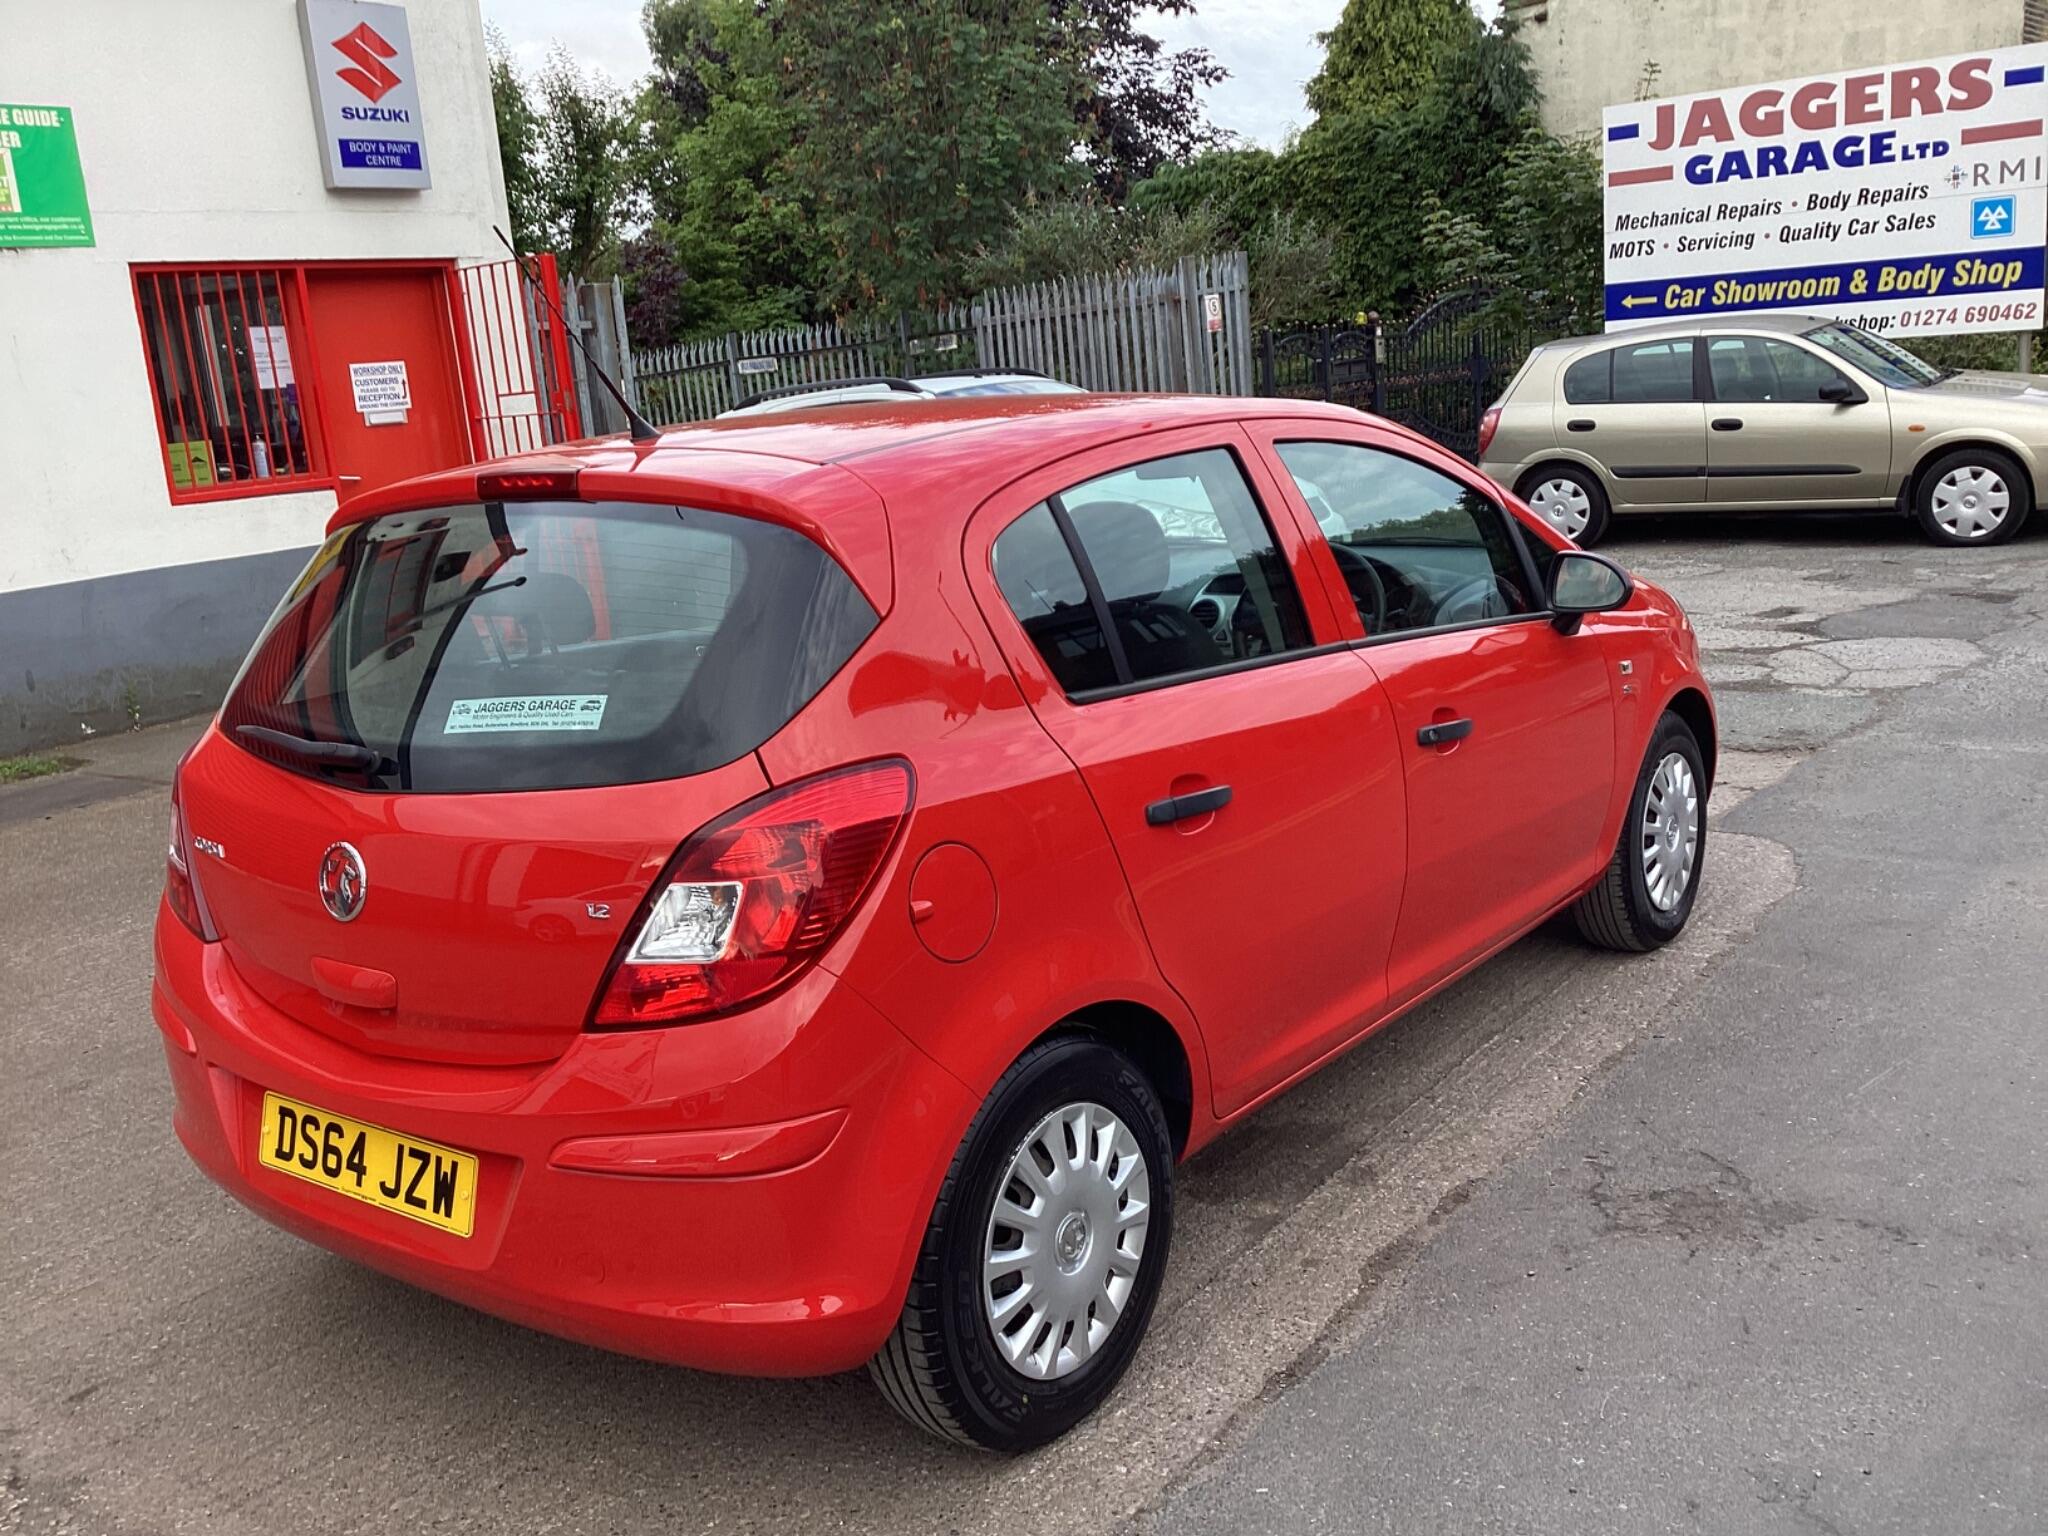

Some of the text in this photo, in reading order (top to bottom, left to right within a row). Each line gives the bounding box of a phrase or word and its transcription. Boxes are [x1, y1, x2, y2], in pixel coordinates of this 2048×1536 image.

[341, 106, 410, 123] SUZUKI
[1648, 58, 1993, 150] JAGGERS
[12, 108, 61, 127] GUIDE
[349, 141, 412, 154] BODY & PAINT
[1685, 130, 1949, 185] GARAGE LTD
[365, 154, 402, 166] CENTRE
[1973, 156, 2041, 187] RMI
[1614, 182, 1930, 232] Mechanical Repairs Body Repairs
[1608, 212, 1936, 260] MOTS Servicing Quality Car Sales
[1664, 258, 2023, 310] Car Showroom & Body Shop
[1899, 307, 1959, 328] 01274
[1964, 302, 2038, 323] 690462
[352, 364, 403, 376] WORKSHOP ONLY
[354, 377, 400, 387] CUSTOMERS
[358, 392, 401, 403] RECEPTION
[473, 699, 577, 713] JAGGERS GARAGE
[275, 1105, 459, 1219] DS64 JZW
